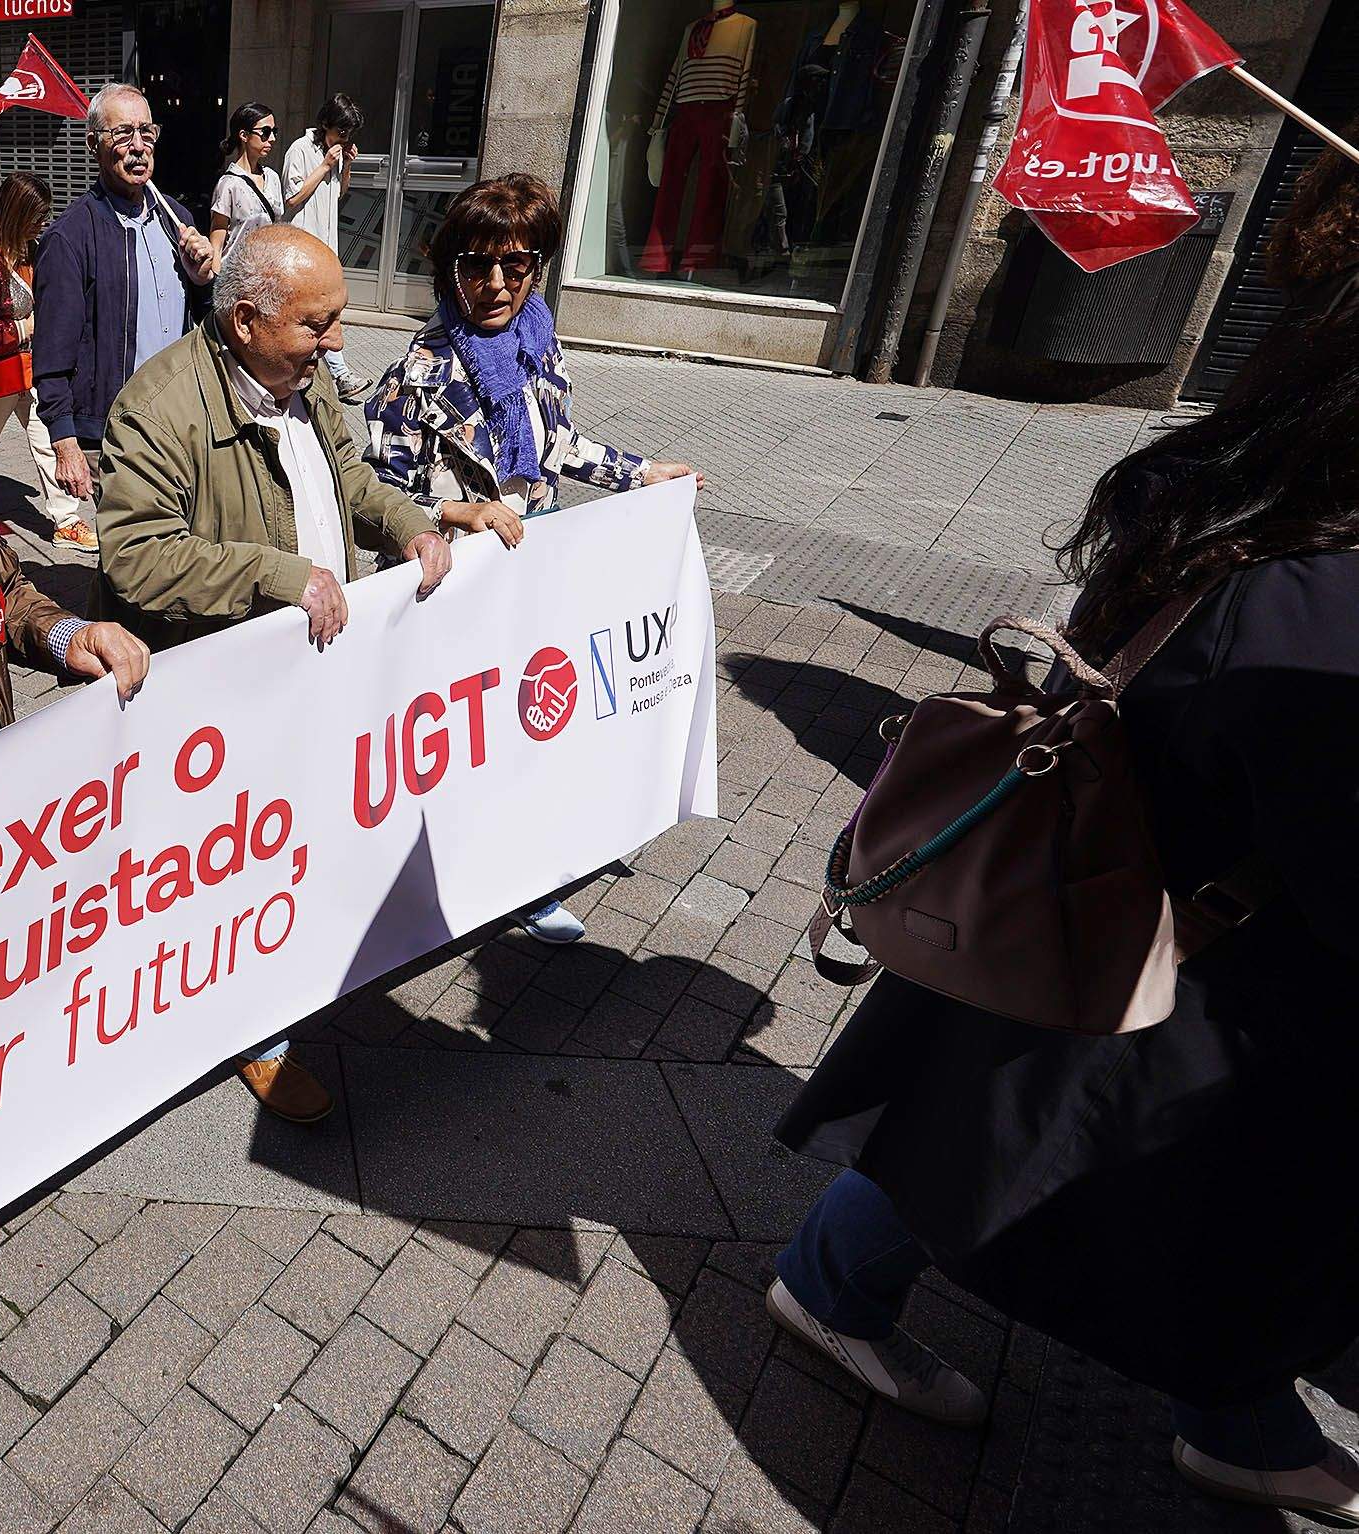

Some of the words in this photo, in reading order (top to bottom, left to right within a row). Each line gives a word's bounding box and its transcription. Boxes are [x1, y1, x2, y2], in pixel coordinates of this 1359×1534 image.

[174, 727, 225, 792] o
[353, 667, 501, 829] UGT
[64, 892, 295, 1064] futuro
